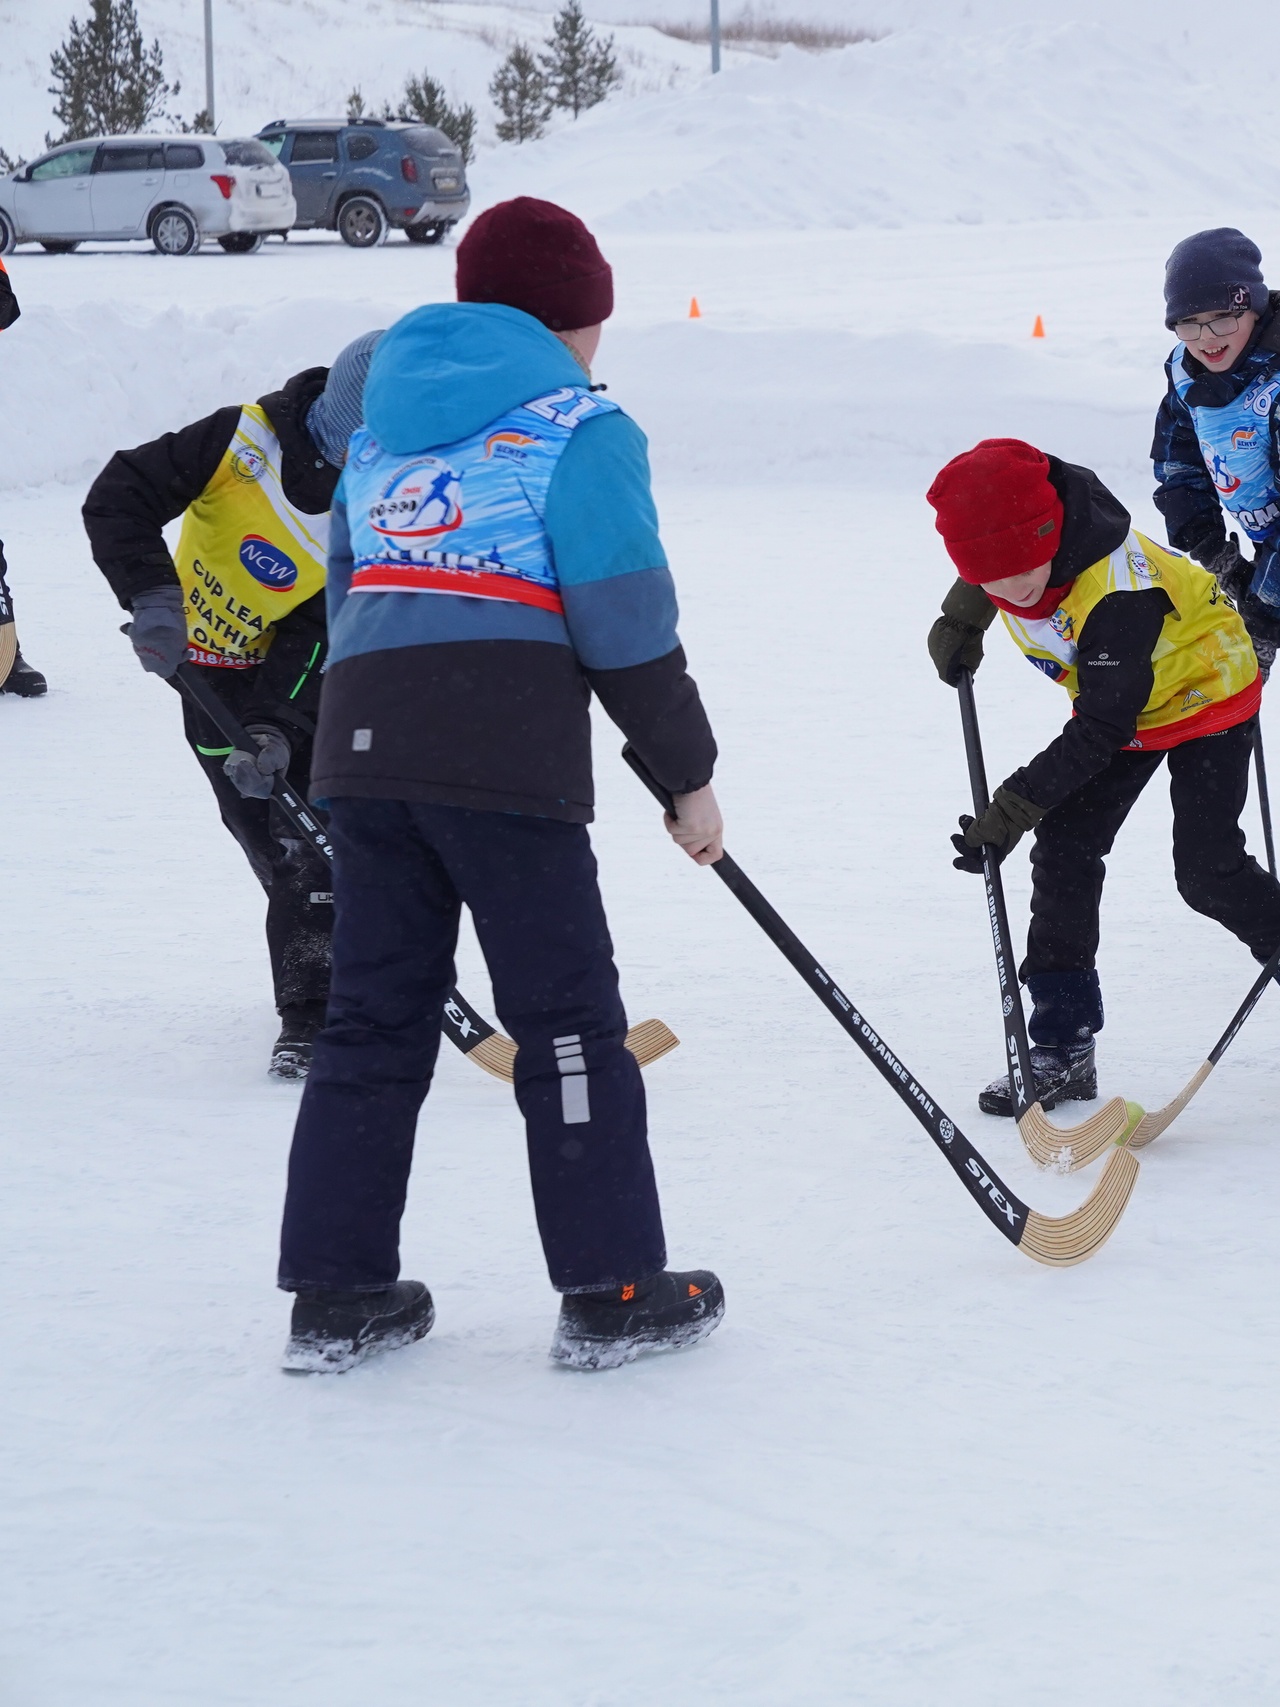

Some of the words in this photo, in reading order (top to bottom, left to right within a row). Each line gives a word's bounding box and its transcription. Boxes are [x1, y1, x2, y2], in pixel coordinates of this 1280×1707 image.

[522, 386, 599, 430] 21
[1243, 373, 1280, 417] 36
[240, 544, 296, 580] NCW
[193, 559, 224, 597] CUP
[225, 597, 270, 633] LEA
[988, 895, 1003, 955] ORANGE
[997, 955, 1008, 990] HAIL
[443, 997, 480, 1039] EX
[860, 1023, 910, 1084] ORANGE
[908, 1082, 935, 1118] HAIL
[1007, 1034, 1027, 1108] STEX
[964, 1157, 1021, 1227] STEX
